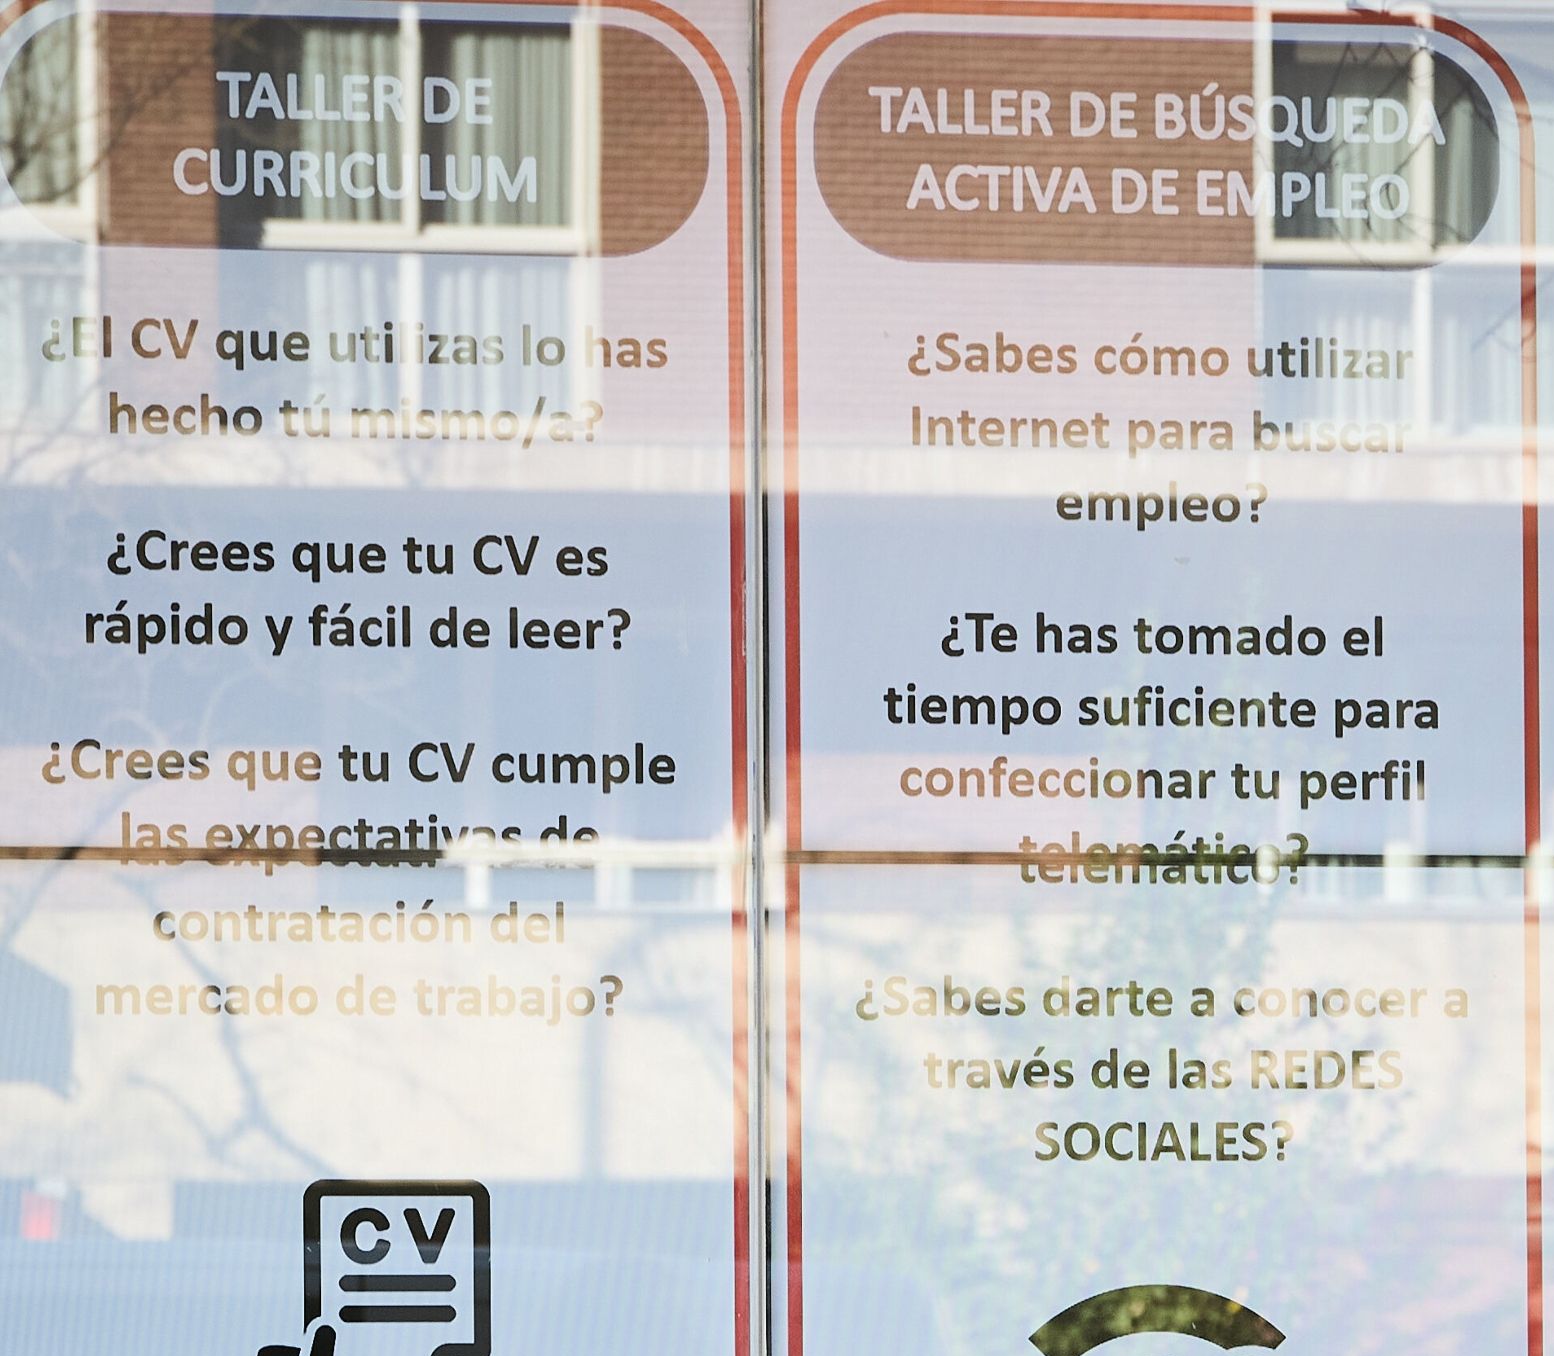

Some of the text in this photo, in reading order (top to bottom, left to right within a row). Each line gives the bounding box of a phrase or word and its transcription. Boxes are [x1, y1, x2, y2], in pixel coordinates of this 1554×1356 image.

[216, 71, 493, 125] TALLER DE
[868, 81, 1446, 148] TALLER DE BÚSQUEDA
[173, 148, 538, 203] CURRICULUM
[906, 164, 1409, 220] ACTIVA DE EMPLEO
[40, 316, 113, 363] ¿El
[131, 318, 199, 361] CV
[216, 325, 310, 370] que
[522, 324, 566, 366] lo
[585, 325, 669, 368] has
[908, 331, 1414, 380] ¿Sabes cómo utilizar
[108, 393, 604, 449] hecho tú mismo/a?
[912, 405, 1408, 459] Internet para buscar
[1057, 482, 1268, 531] empleo?
[107, 530, 609, 582] ¿Crees que tu CV es
[84, 600, 631, 656] rápido y fácil de leer?
[942, 612, 1383, 657] ¿Te has tomado el
[884, 684, 1439, 738] tiempo suficiente para
[41, 738, 677, 794] ¿Crees que tu CV cumple
[899, 756, 1426, 810] confeccionar tu perfil
[121, 811, 188, 866] las
[1018, 830, 1309, 885] telemático?
[153, 900, 565, 944] contratación del
[96, 974, 623, 1026] mercado de trabajo?
[855, 975, 1469, 1021] ¿Sabes darte a conocer a
[923, 1047, 1403, 1090] través de las REDES
[1034, 1119, 1293, 1162] SOCIALES?
[340, 1207, 455, 1265] CV
